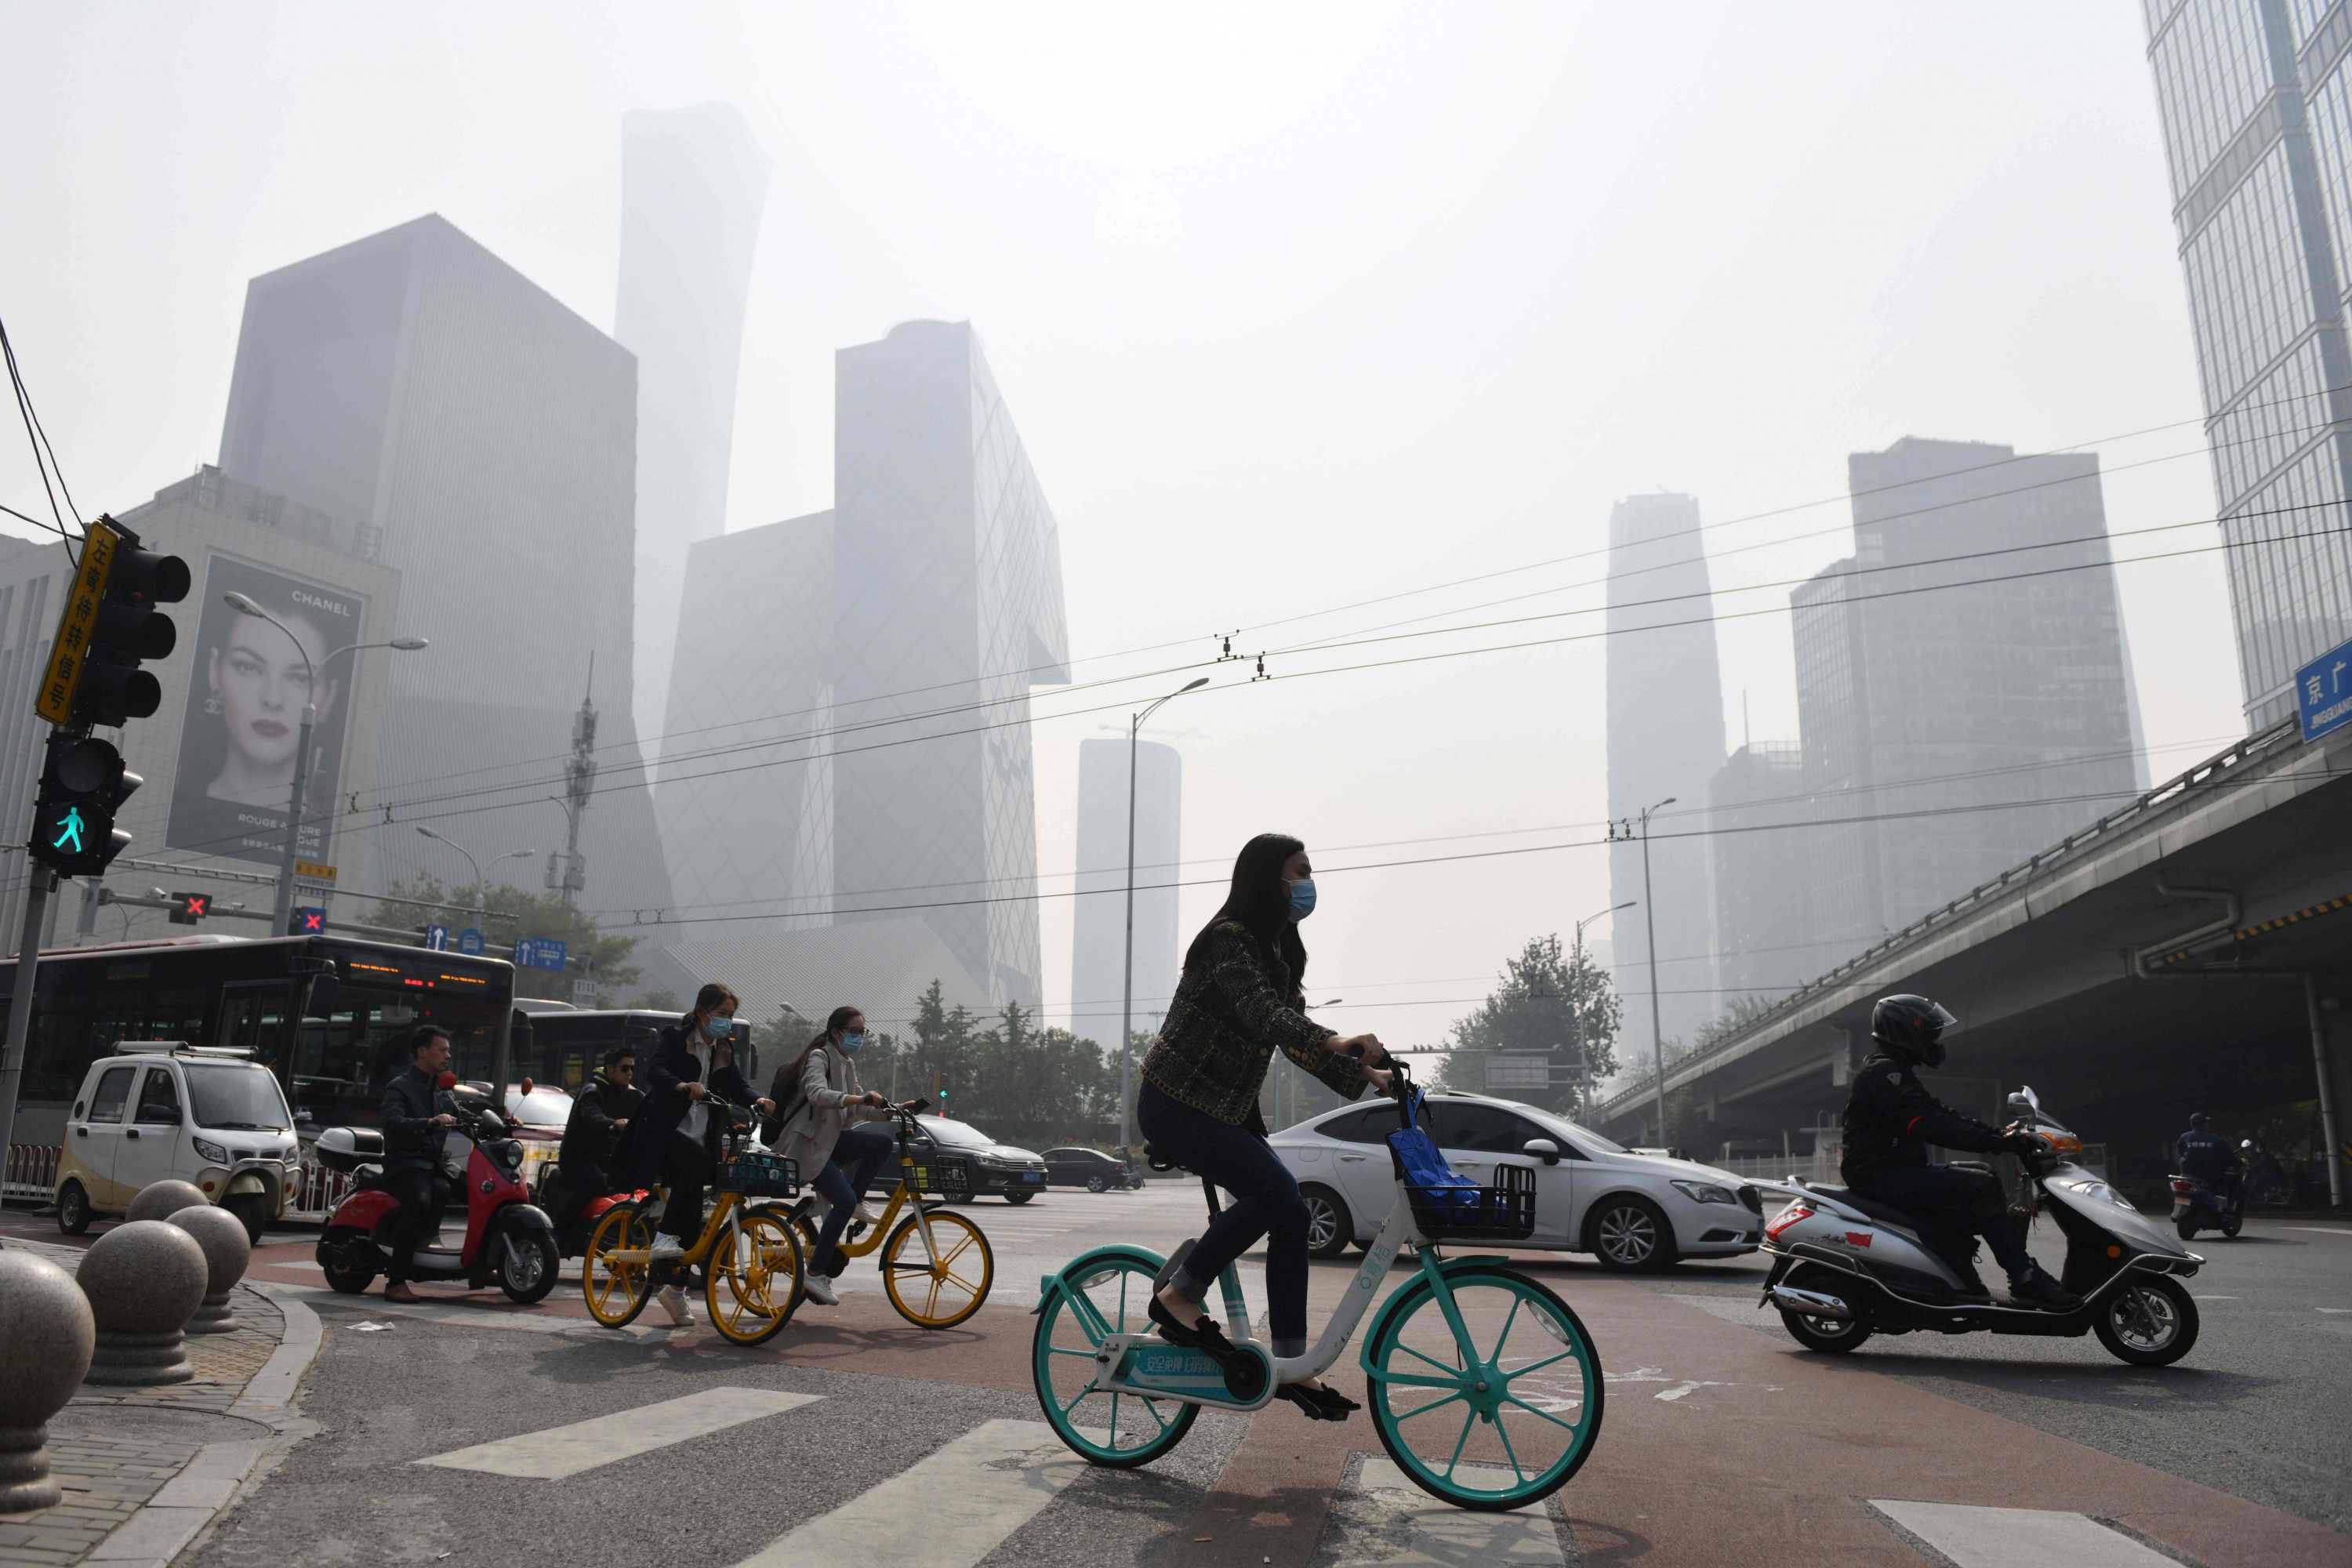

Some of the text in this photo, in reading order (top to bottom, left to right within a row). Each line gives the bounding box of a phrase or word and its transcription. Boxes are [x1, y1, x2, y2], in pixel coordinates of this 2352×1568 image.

[292, 590, 350, 618] CHANEL
[2305, 660, 2347, 706] 京广
[238, 813, 278, 829] ROUGE
[1363, 1243, 1392, 1277] 青桔
[1145, 1356, 1183, 1373] 安全免押
